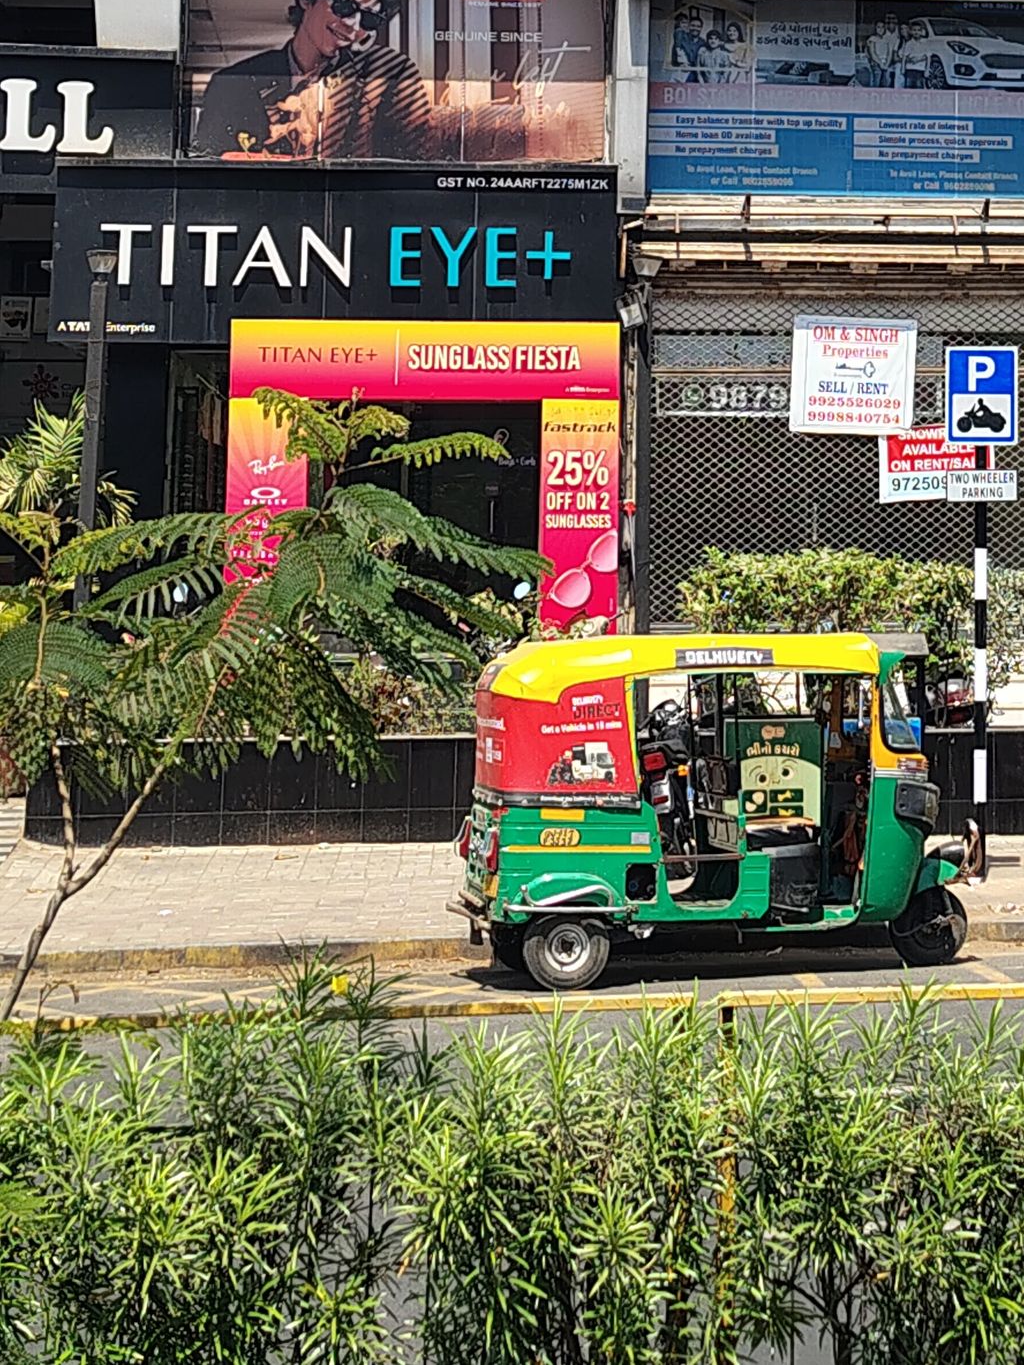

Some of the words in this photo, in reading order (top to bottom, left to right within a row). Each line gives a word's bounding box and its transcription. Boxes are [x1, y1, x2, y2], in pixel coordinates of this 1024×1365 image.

[434, 30, 498, 42] GENUINE
[500, 31, 543, 43] SINCE
[437, 176, 465, 189] GST
[466, 177, 489, 189] NO.
[100, 223, 352, 288] TITAN
[390, 226, 571, 288] EYE+
[57, 322, 66, 332] A
[67, 322, 90, 332] TAT
[106, 322, 155, 334] Enterprise
[813, 325, 836, 342] OM
[840, 326, 851, 342] &
[855, 326, 899, 343] SINGH
[258, 346, 322, 363] TITAN
[330, 347, 379, 364] EYE+
[407, 345, 510, 371] SUNGLASS
[515, 345, 581, 371] FIESTA
[822, 344, 888, 359] Properties
[967, 355, 996, 392] P
[818, 381, 848, 394] SELL
[857, 382, 889, 395] RENT
[808, 396, 901, 410] 9925526029
[808, 411, 901, 425] 9998840754
[543, 421, 616, 433] fastrack
[902, 442, 975, 456] AVAILABLE
[547, 450, 609, 487] 25%
[950, 472, 971, 483] TWO
[972, 472, 1014, 483] WHEELER
[962, 487, 1003, 498] PARKING
[546, 491, 573, 510] OFF
[577, 491, 597, 510] ON
[600, 490, 609, 510] 2
[545, 514, 612, 529] SUNGLASSES
[573, 702, 621, 720] DIRECT
